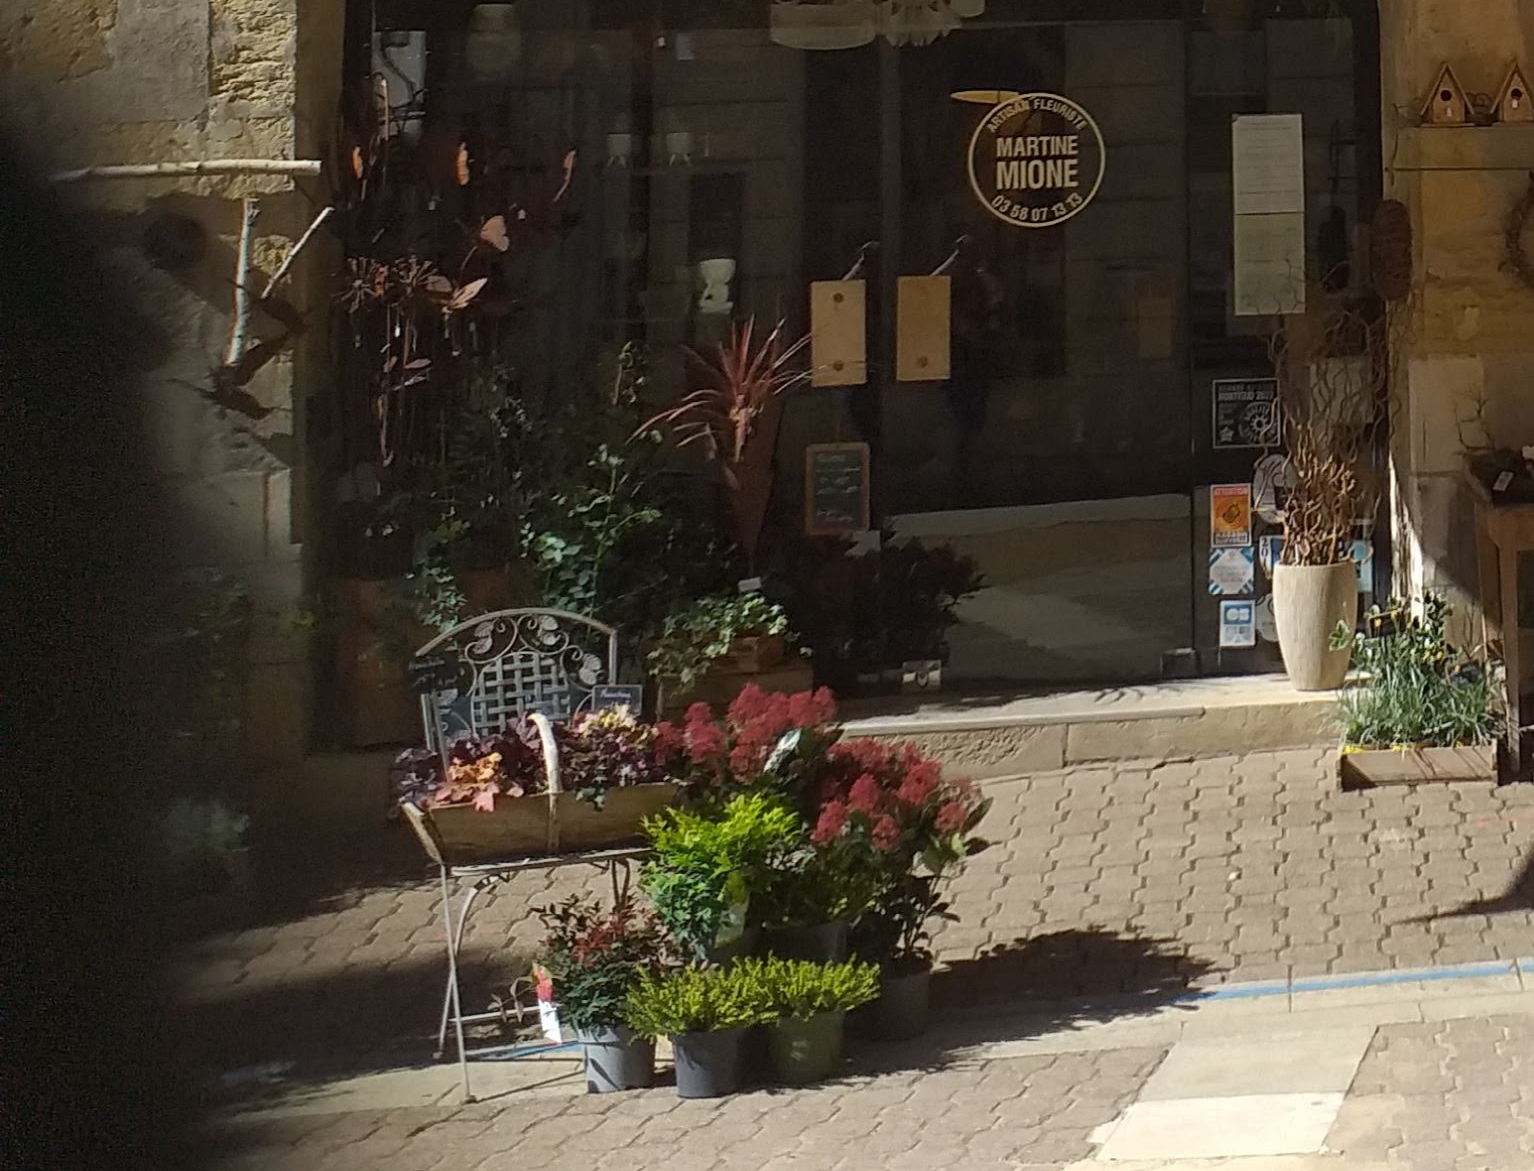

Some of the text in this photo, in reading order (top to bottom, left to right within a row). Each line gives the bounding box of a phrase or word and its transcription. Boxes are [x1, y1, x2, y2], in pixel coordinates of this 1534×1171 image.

[987, 98, 1088, 133] ARTISAN FLEURISTE
[996, 135, 1079, 157] MARTINE
[996, 158, 1079, 190] MIONE
